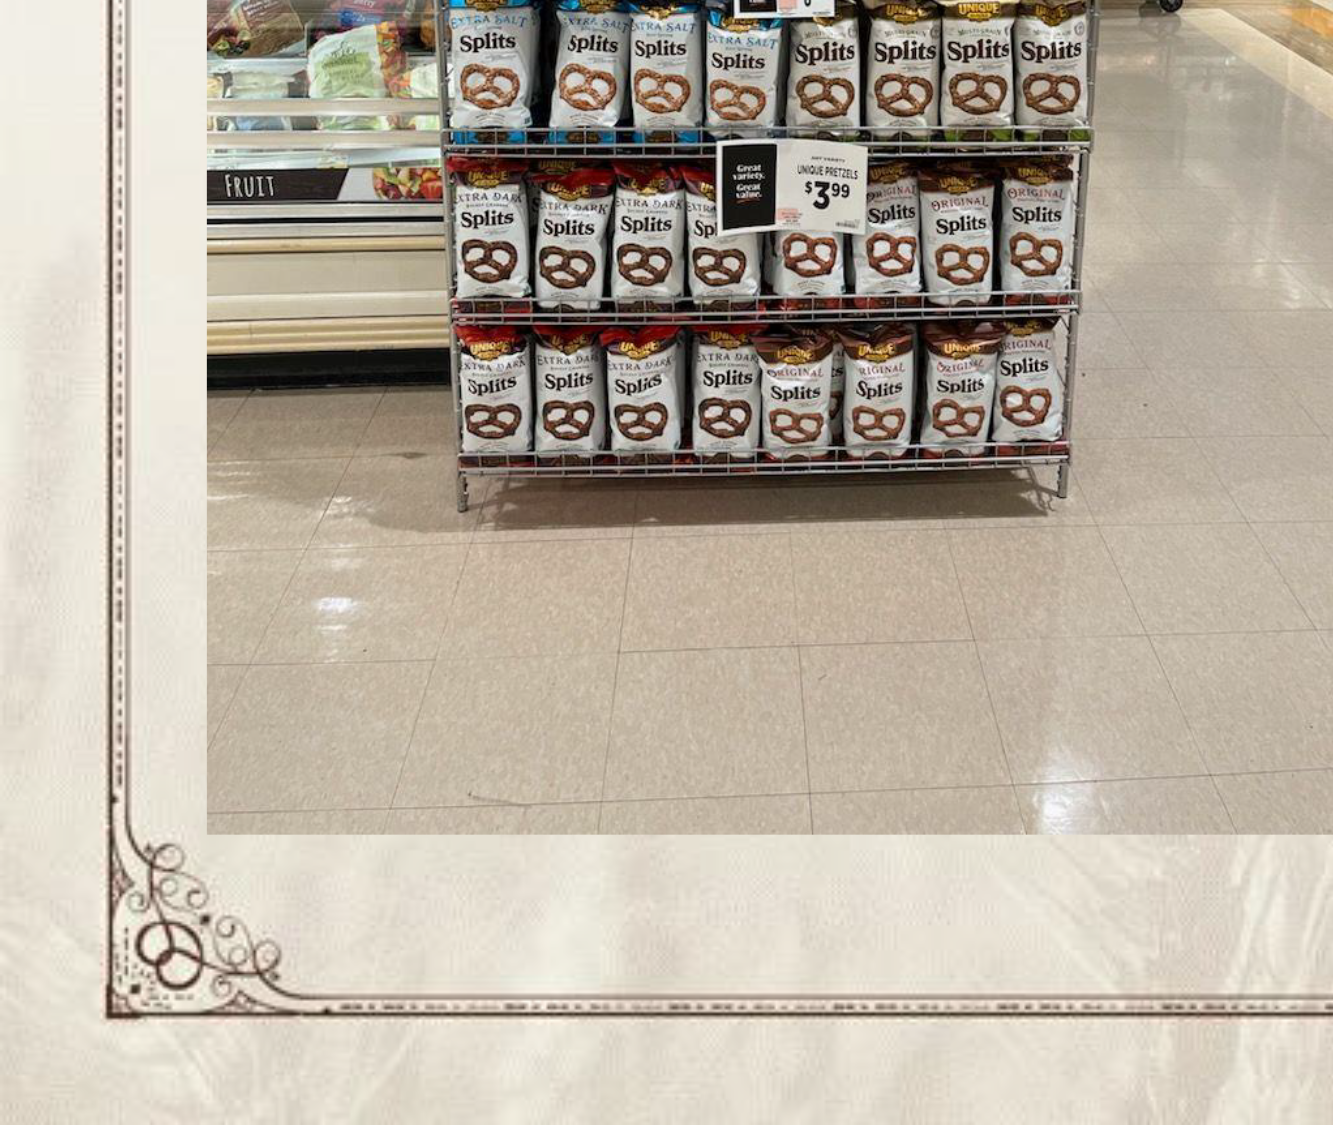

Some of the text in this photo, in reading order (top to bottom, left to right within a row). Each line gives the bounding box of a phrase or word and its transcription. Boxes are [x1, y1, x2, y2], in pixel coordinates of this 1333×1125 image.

[958, 2, 999, 15] UNIQUE
[495, 16, 528, 28] SALT
[568, 35, 618, 54] Splits
[635, 39, 686, 57] Splits
[744, 35, 779, 49] SALT
[795, 41, 855, 65] Splits
[874, 41, 937, 64] Splits
[711, 53, 765, 70] Splits
[736, 164, 762, 172] Great
[797, 165, 858, 179] UNIQUE PRETZELS
[224, 174, 276, 199] FRUIT
[1008, 187, 1065, 201] ORIGINAL
[932, 197, 989, 211] ORIGINAL
[461, 212, 514, 229] Splits
[1012, 206, 1062, 224] Splits
[543, 218, 595, 237] Splits
[621, 216, 672, 233] Splits
[936, 216, 986, 235] Splits
